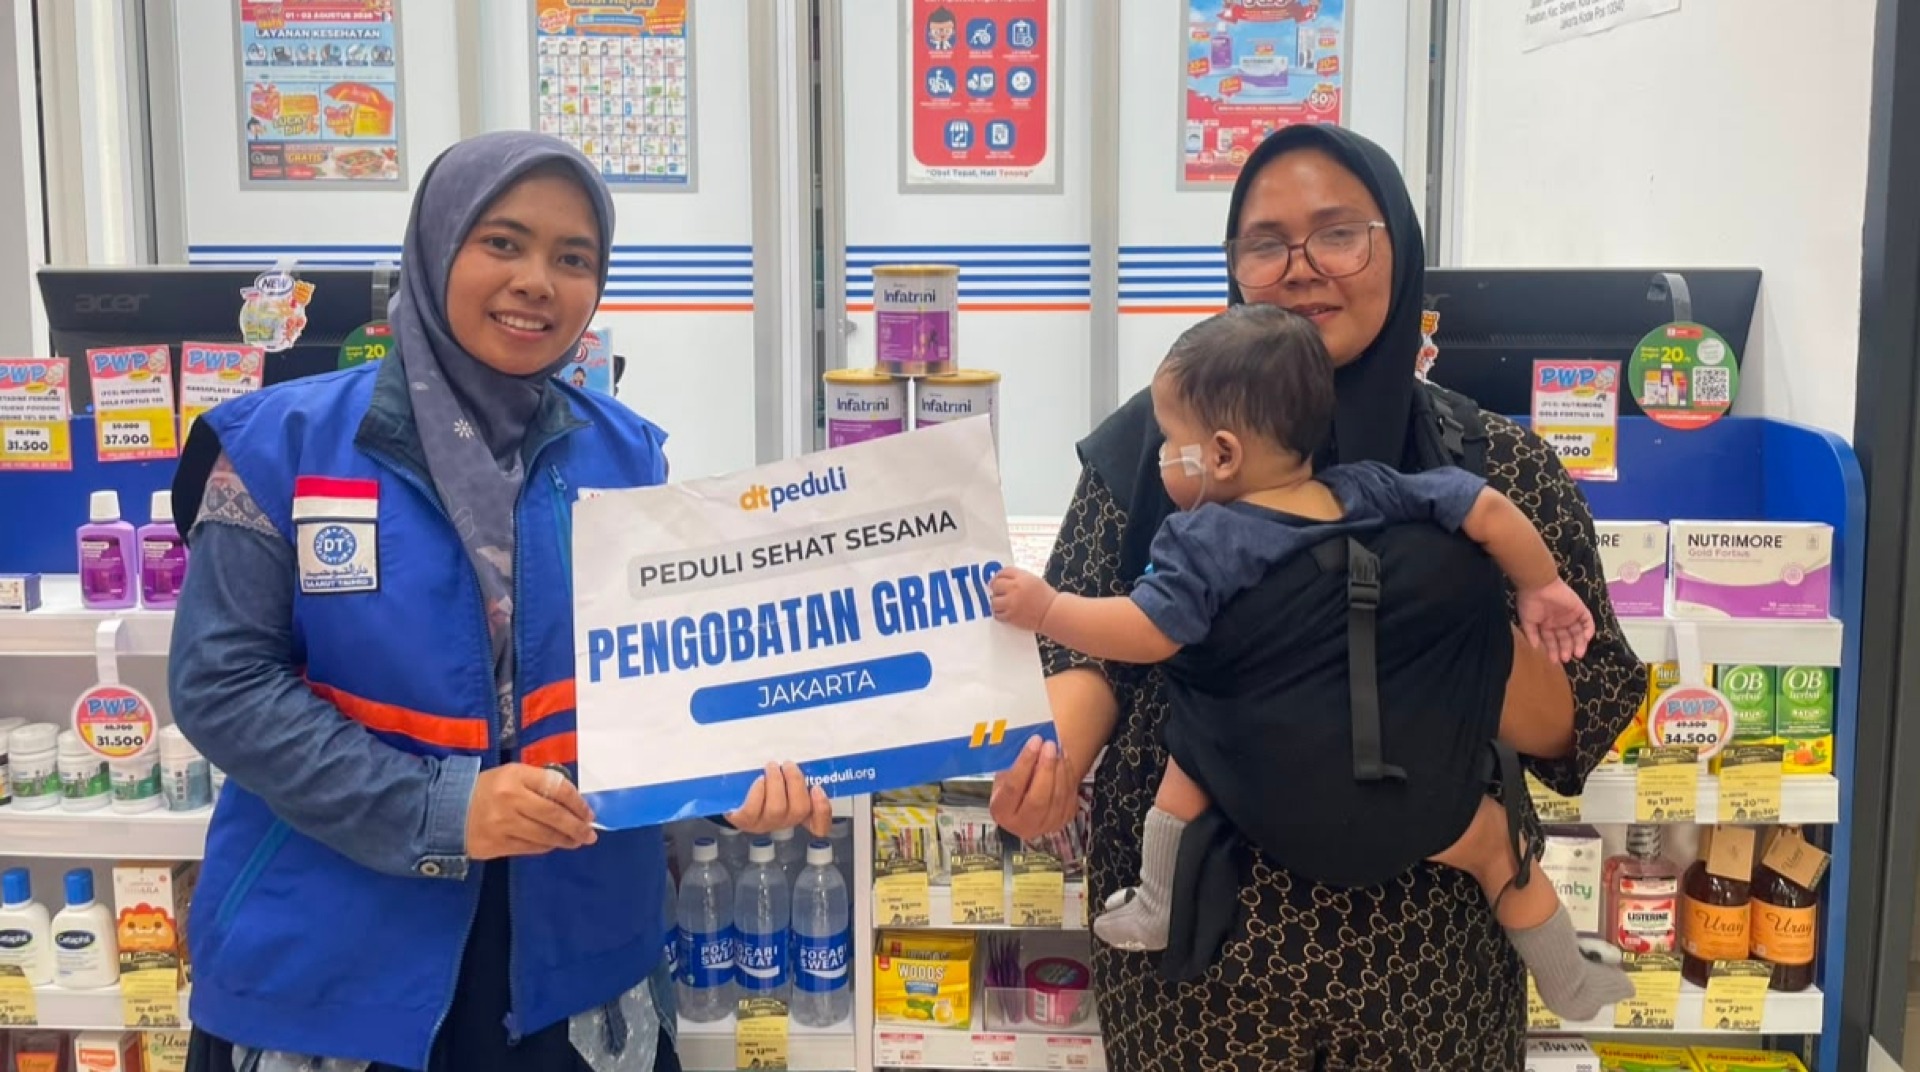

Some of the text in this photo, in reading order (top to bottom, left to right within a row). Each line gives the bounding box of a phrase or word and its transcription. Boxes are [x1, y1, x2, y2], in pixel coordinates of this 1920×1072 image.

[255, 29, 380, 39] LAYANAN KESEHATAN
[261, 276, 288, 289] NEW
[75, 294, 149, 313] acer
[883, 289, 936, 304] Infatrini
[93, 351, 149, 373] PWP
[188, 350, 241, 370] PWP
[1660, 346, 1685, 363] 20
[1540, 366, 1596, 388] PWP
[836, 397, 890, 412] Infatrini
[921, 398, 972, 413] Infatrini
[7, 440, 49, 452] 31.500
[104, 433, 149, 446] 37.900
[739, 465, 848, 512] dtpeduli
[324, 537, 346, 552] DT
[638, 509, 958, 588] PEDULI SEHAT SESAMA
[1687, 533, 1782, 549] NUTRIMORE
[587, 586, 862, 683] PENGOBATAN
[757, 668, 877, 708] JAKARTA
[1728, 671, 1763, 691] OB
[1788, 670, 1823, 690] OB
[87, 698, 139, 717] PWP
[1666, 699, 1719, 718] PWP
[96, 735, 144, 747] 31.500
[1664, 733, 1717, 744] 34.500
[1627, 912, 1669, 922] LISTERINE
[1695, 909, 1744, 937] Uray
[0, 932, 28, 944] etaphil
[57, 934, 91, 946] Cetaphil
[800, 943, 847, 961] POCARI
[800, 956, 844, 970] SWEAT
[897, 963, 945, 980] WOODS
[154, 1033, 187, 1048] Ura
